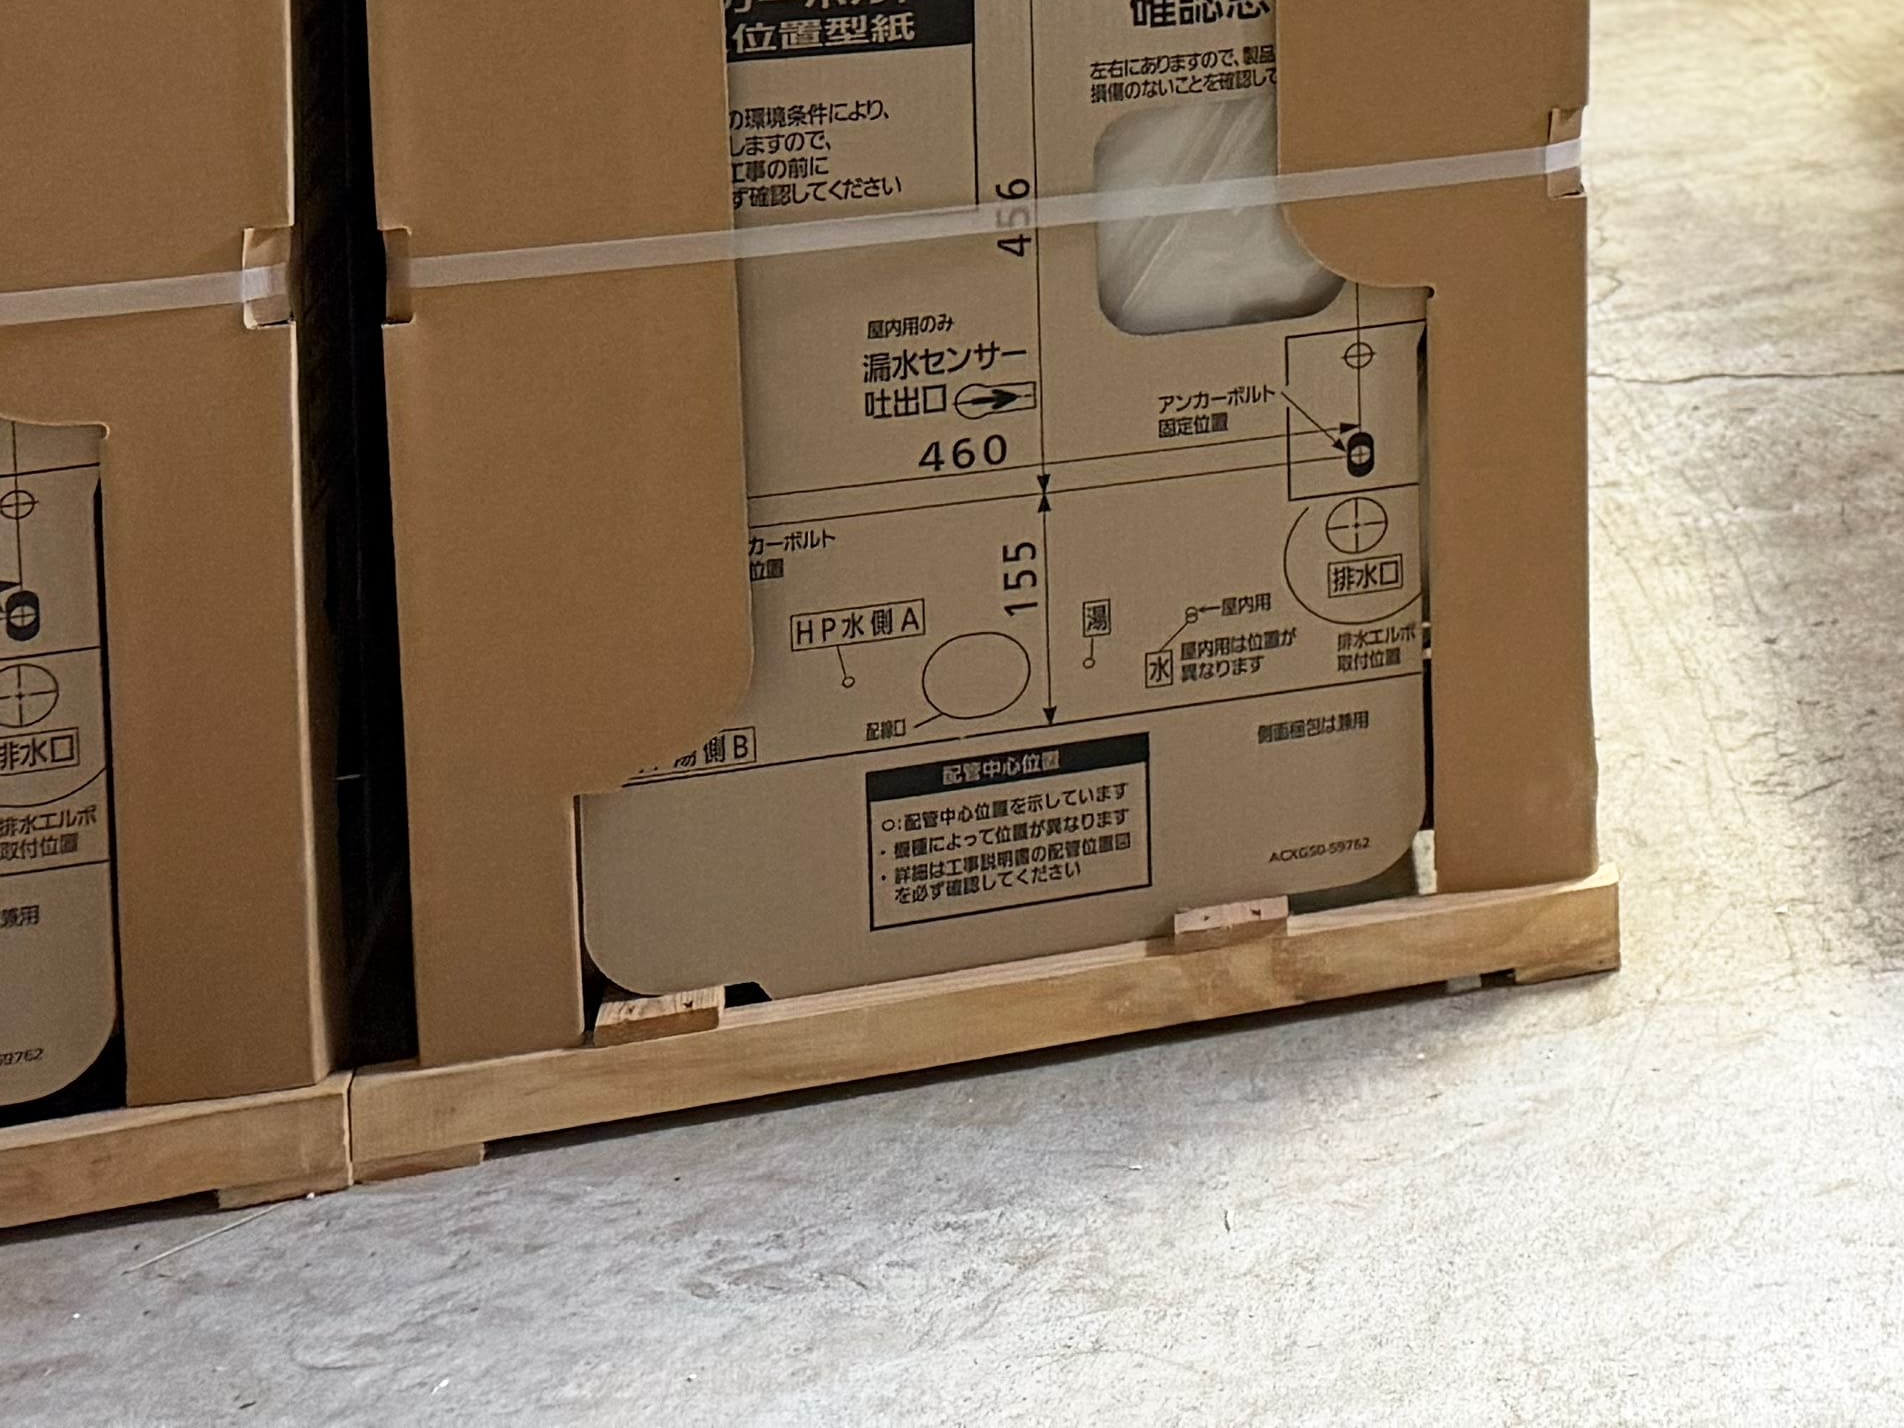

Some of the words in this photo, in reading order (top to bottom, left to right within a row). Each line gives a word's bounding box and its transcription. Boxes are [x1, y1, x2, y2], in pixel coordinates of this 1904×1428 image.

[863, 341, 1027, 384] 漏水センサー
[865, 383, 947, 420] 吐出口
[1157, 385, 1273, 415] アンカーボルト
[1158, 411, 1228, 439] 固定位置
[919, 435, 1008, 472] 460
[1002, 542, 1038, 617] 155
[1332, 560, 1399, 594] 排水口
[1150, 657, 1170, 683] 水
[942, 751, 1061, 785] 配管中心位置
